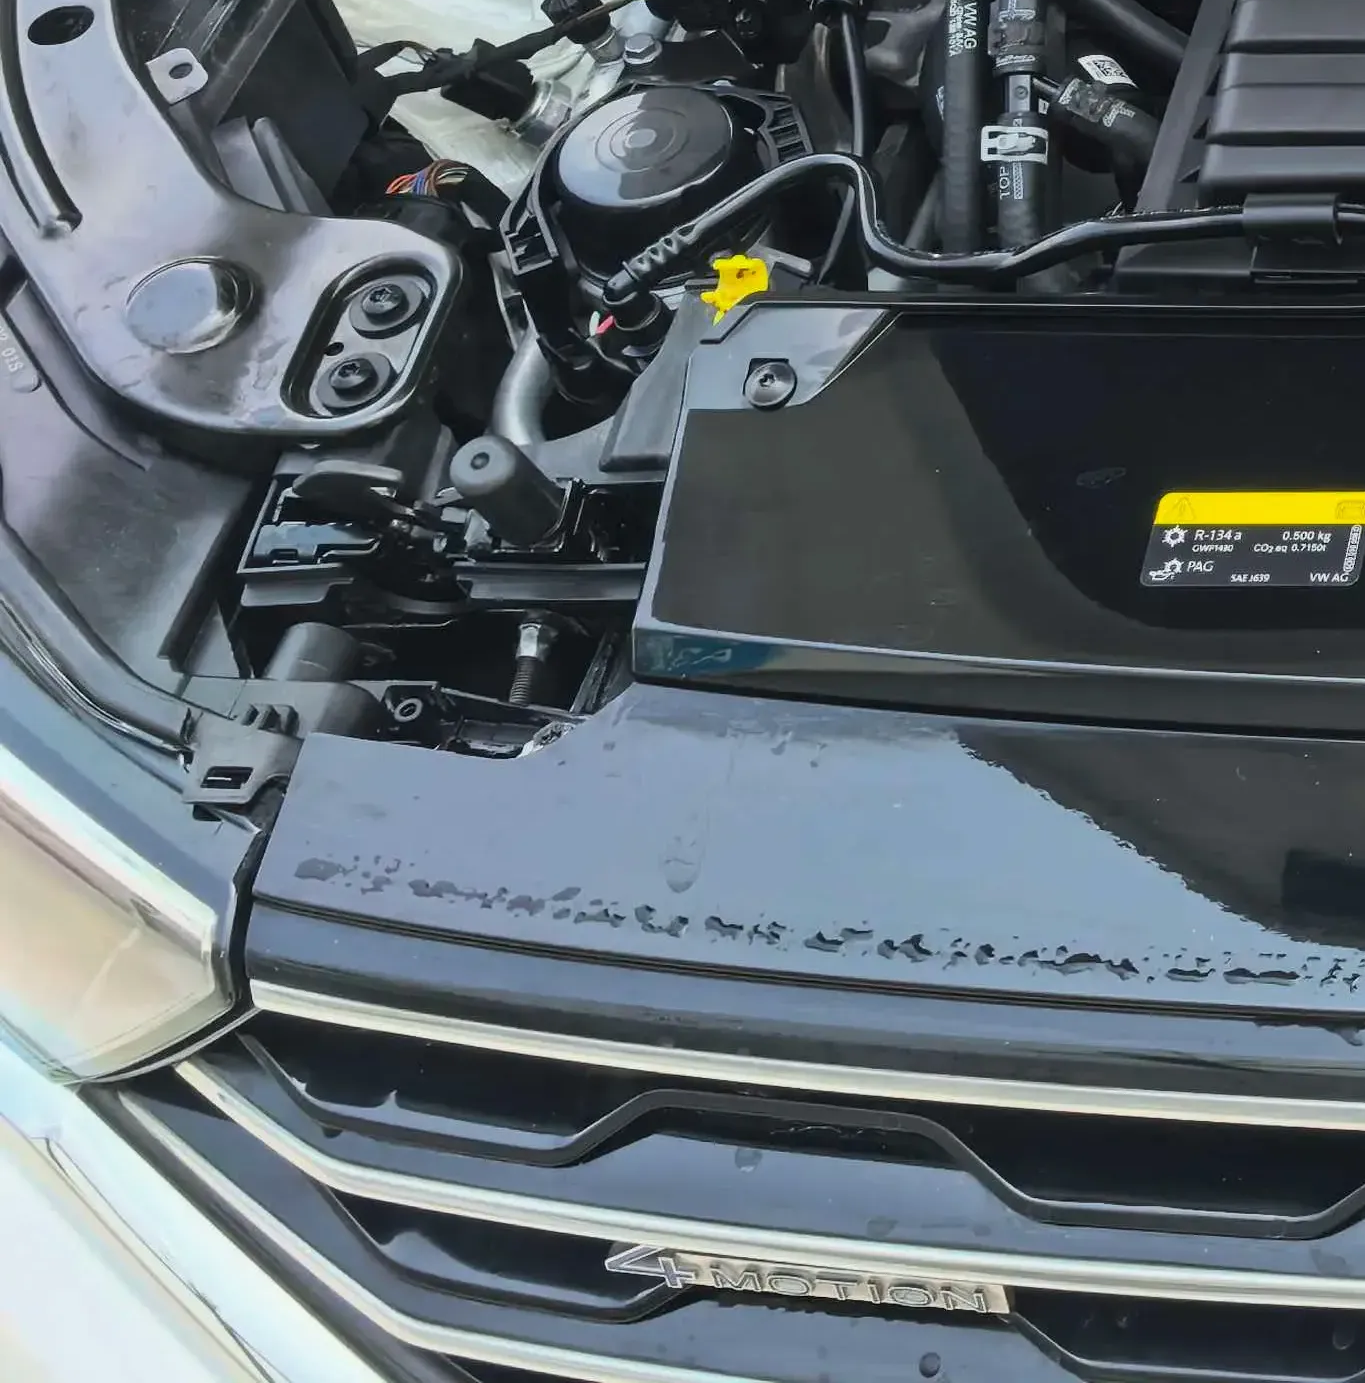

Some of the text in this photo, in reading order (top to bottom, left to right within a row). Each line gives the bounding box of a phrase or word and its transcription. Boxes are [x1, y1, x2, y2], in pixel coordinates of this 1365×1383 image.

[963, 27, 978, 49] AG
[999, 166, 1011, 201] TOP
[1282, 530, 1315, 541] 0.500
[1317, 530, 1332, 544] kg
[1186, 559, 1215, 573] PAG
[1230, 573, 1248, 583] SAE
[1309, 572, 1350, 583] VW AG
[604, 1244, 992, 1314] 4MOTION
